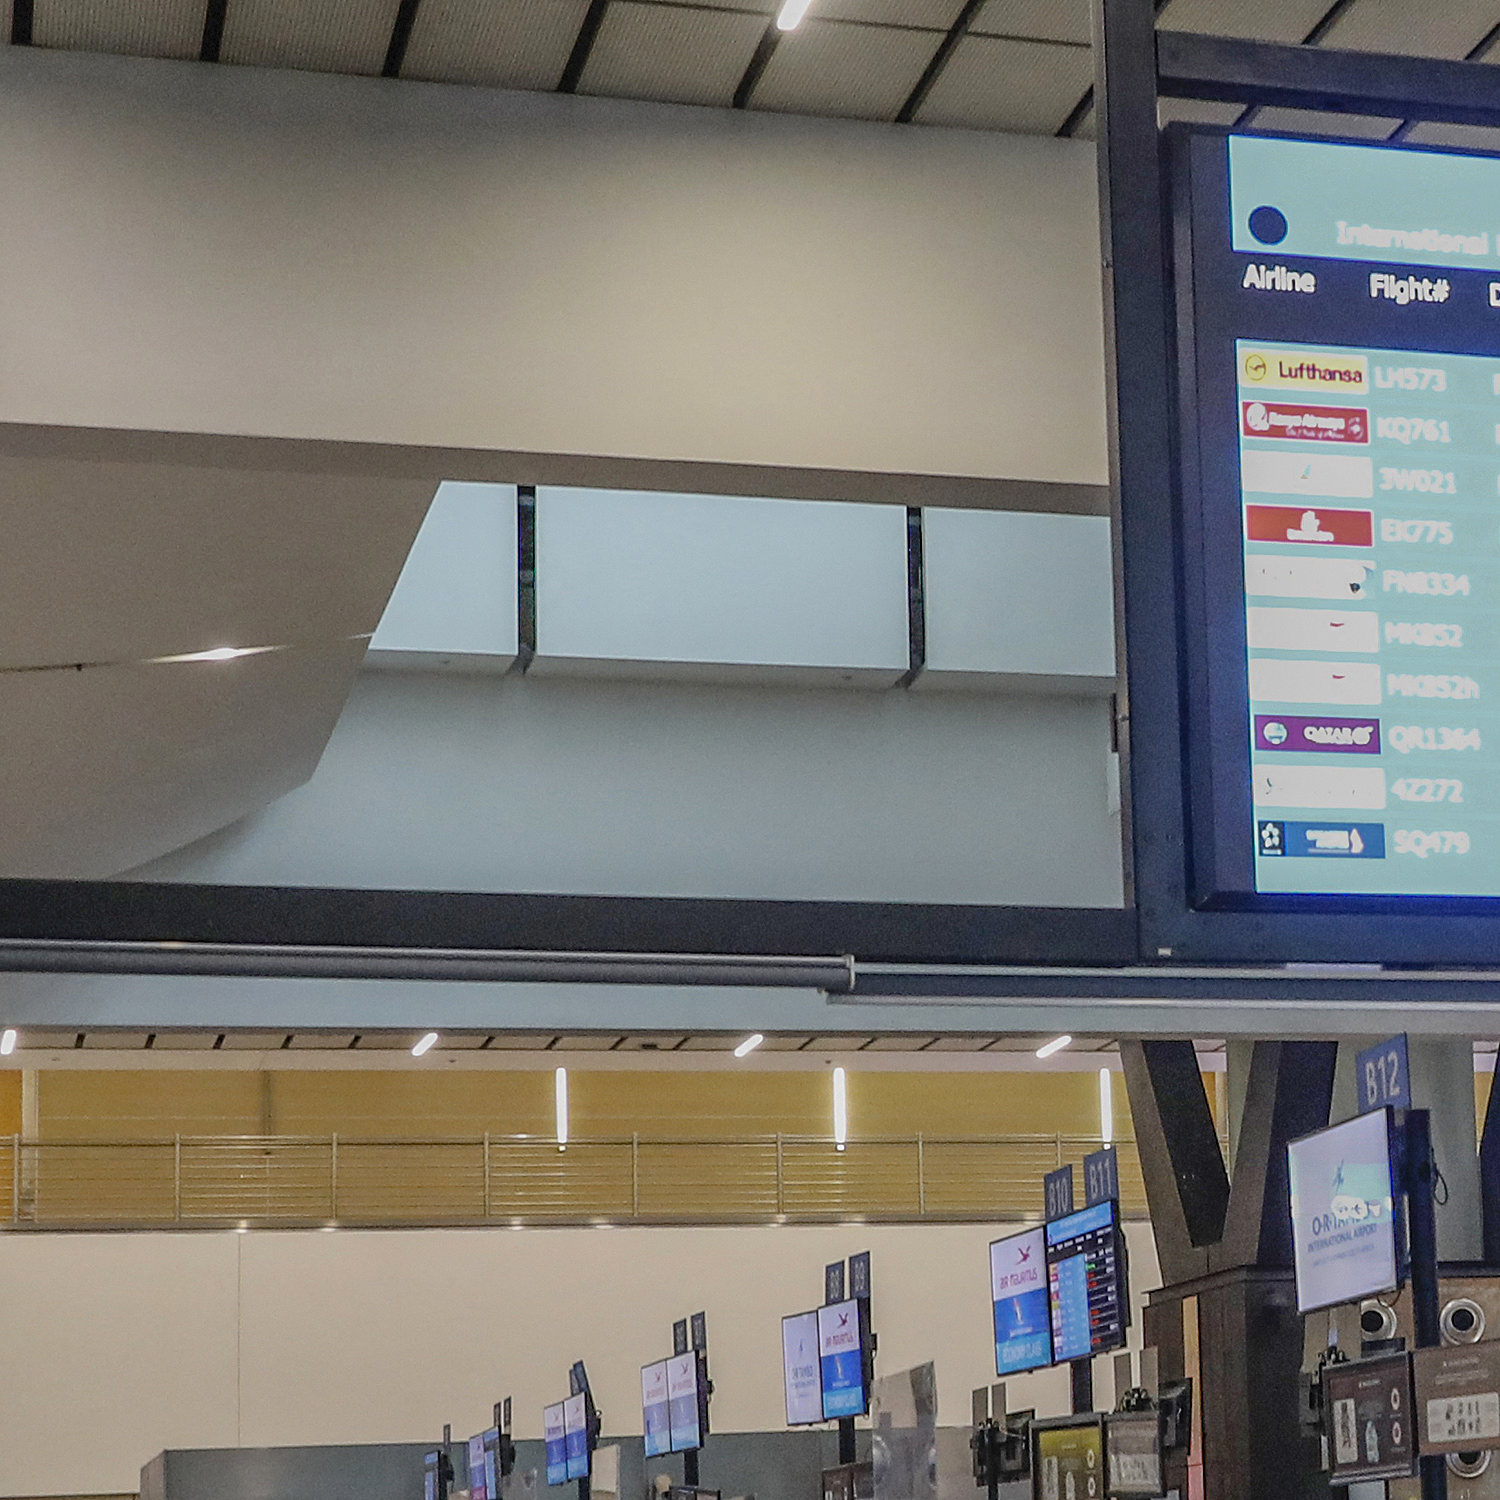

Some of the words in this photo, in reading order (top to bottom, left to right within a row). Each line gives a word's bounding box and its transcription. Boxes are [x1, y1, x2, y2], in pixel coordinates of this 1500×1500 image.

[1337, 221, 1488, 255] International
[1243, 264, 1315, 292] Airline
[1370, 273, 1449, 304] Flight#
[1279, 361, 1362, 383] Lufthansa
[1365, 1051, 1400, 1106] B12
[1049, 1177, 1070, 1217] B10
[1089, 1157, 1113, 1199] B11
